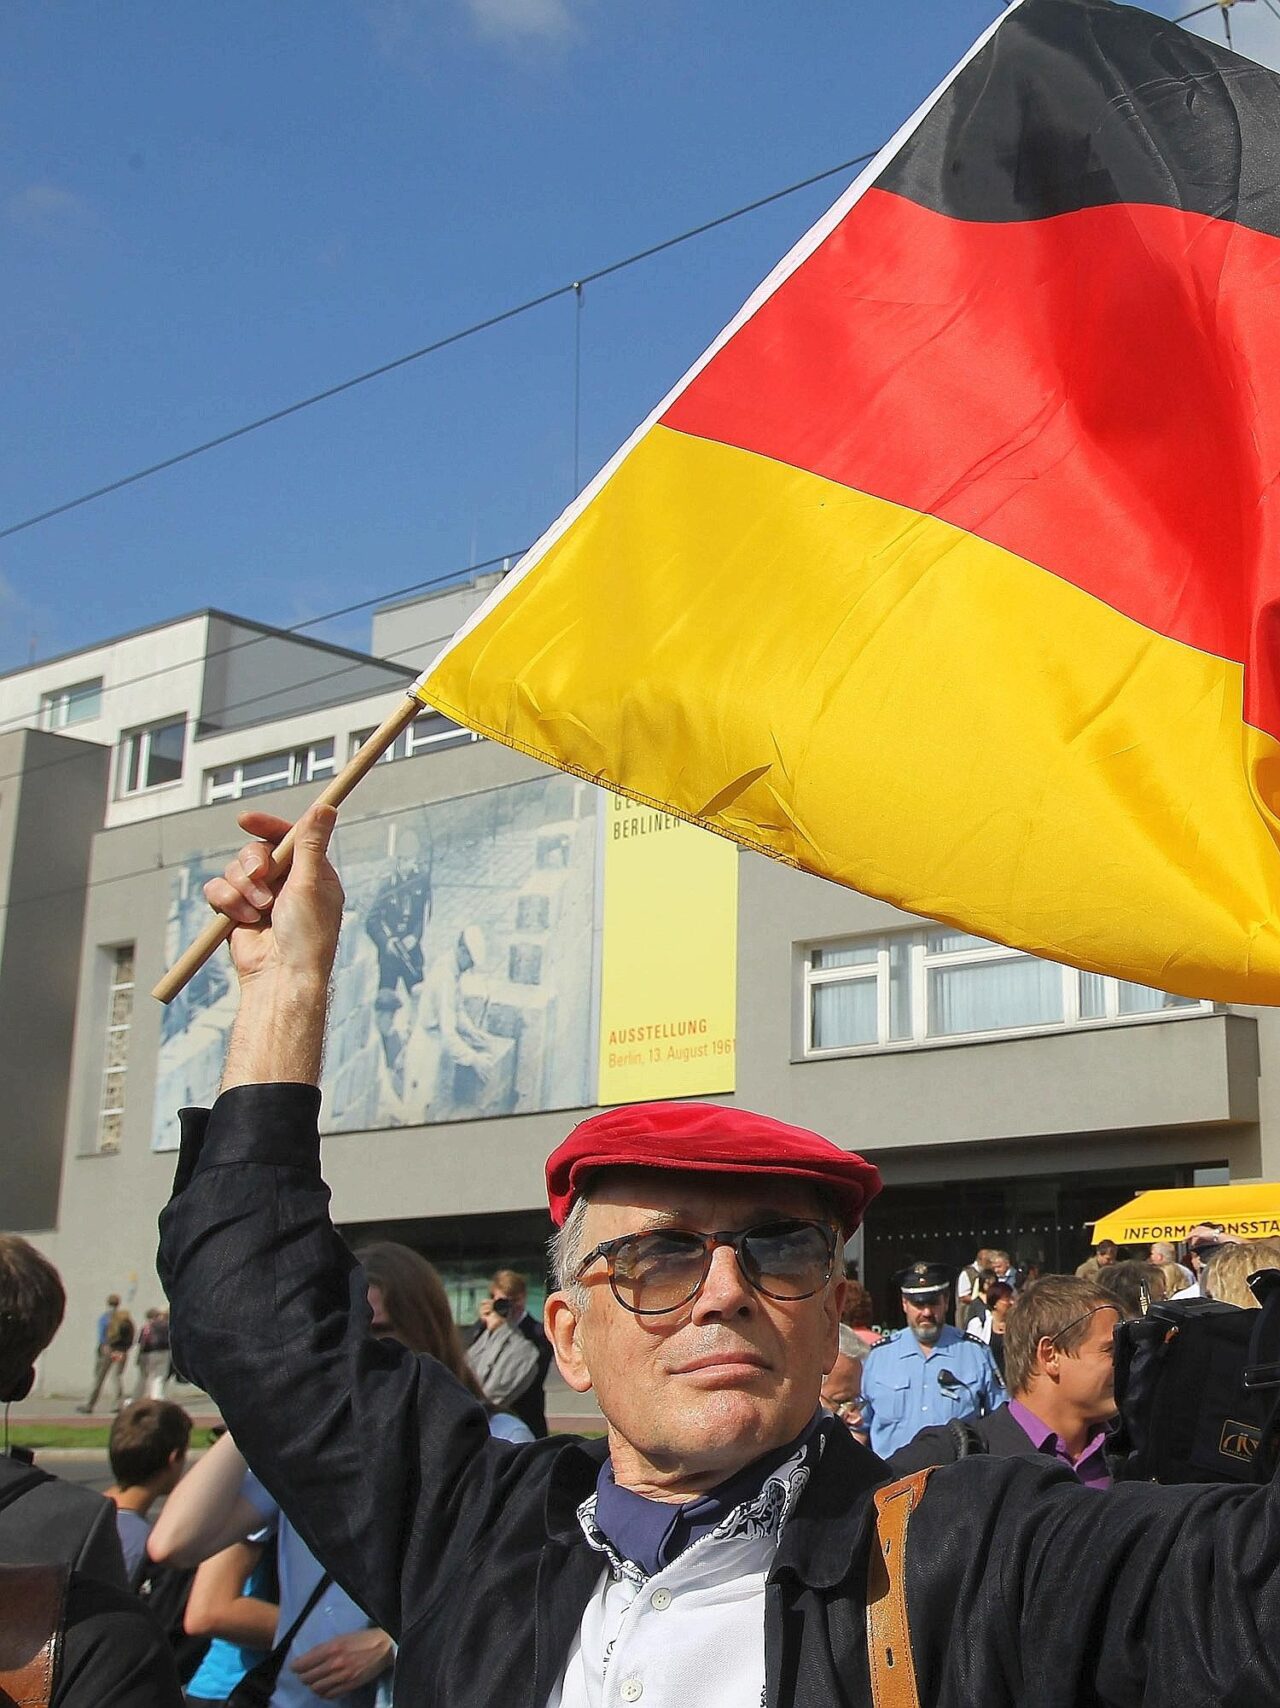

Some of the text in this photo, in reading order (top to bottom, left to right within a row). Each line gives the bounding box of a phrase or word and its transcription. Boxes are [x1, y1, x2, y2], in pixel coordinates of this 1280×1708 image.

[608, 1018, 707, 1045] AUSSTELLUNG
[608, 1052, 645, 1068] Berlin,
[667, 1044, 708, 1062] August
